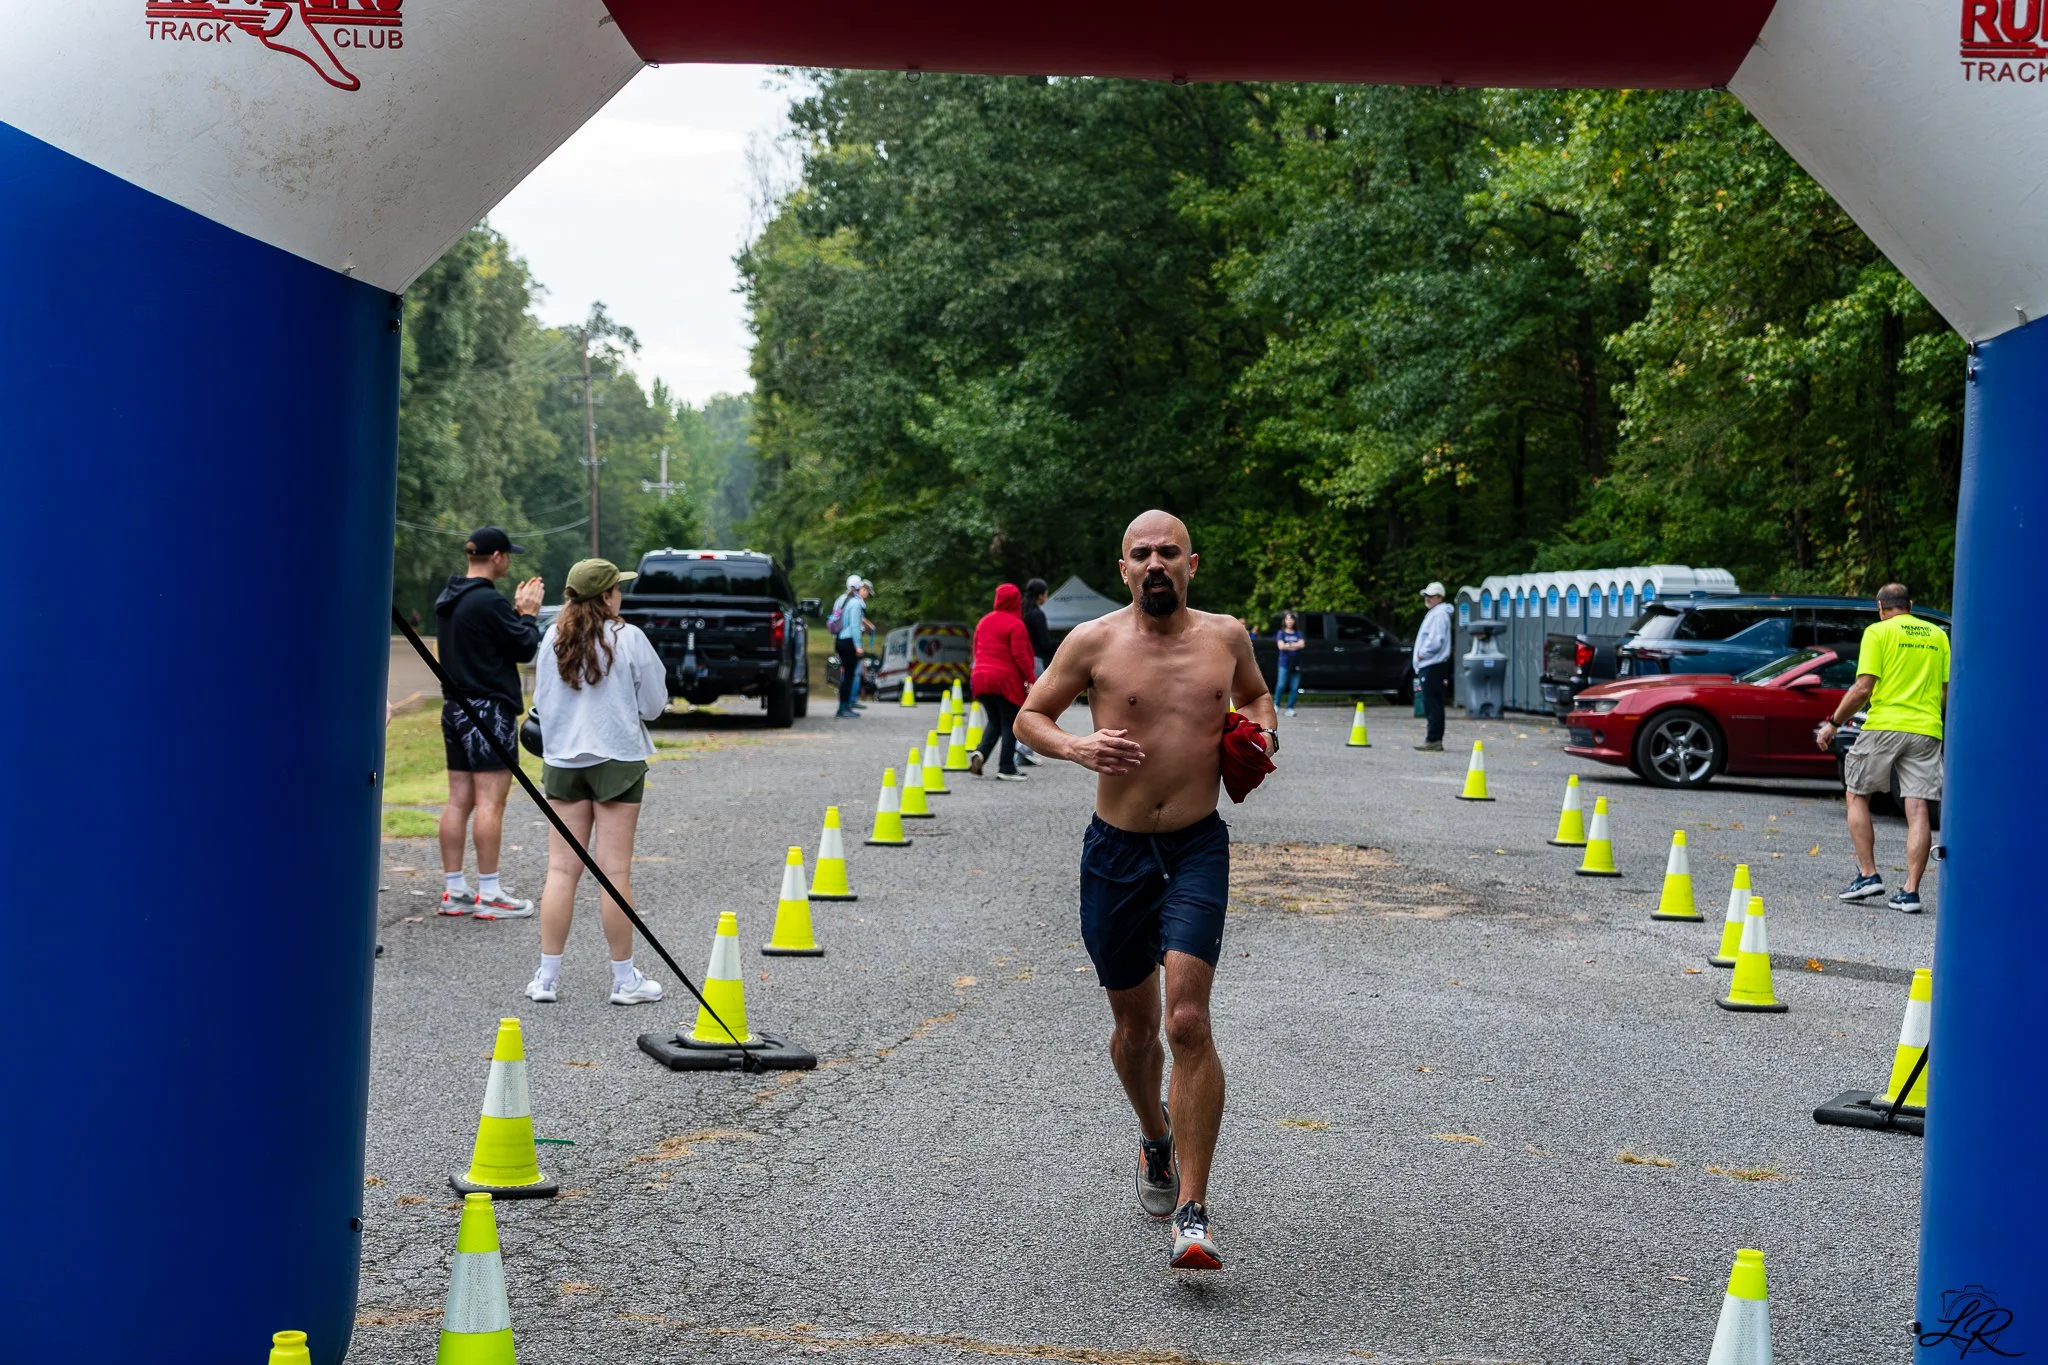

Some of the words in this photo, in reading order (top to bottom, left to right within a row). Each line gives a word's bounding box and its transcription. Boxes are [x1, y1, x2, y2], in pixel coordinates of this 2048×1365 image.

[146, 21, 232, 43] TRACK
[333, 27, 404, 49] CLUB
[1961, 0, 2048, 42] RU
